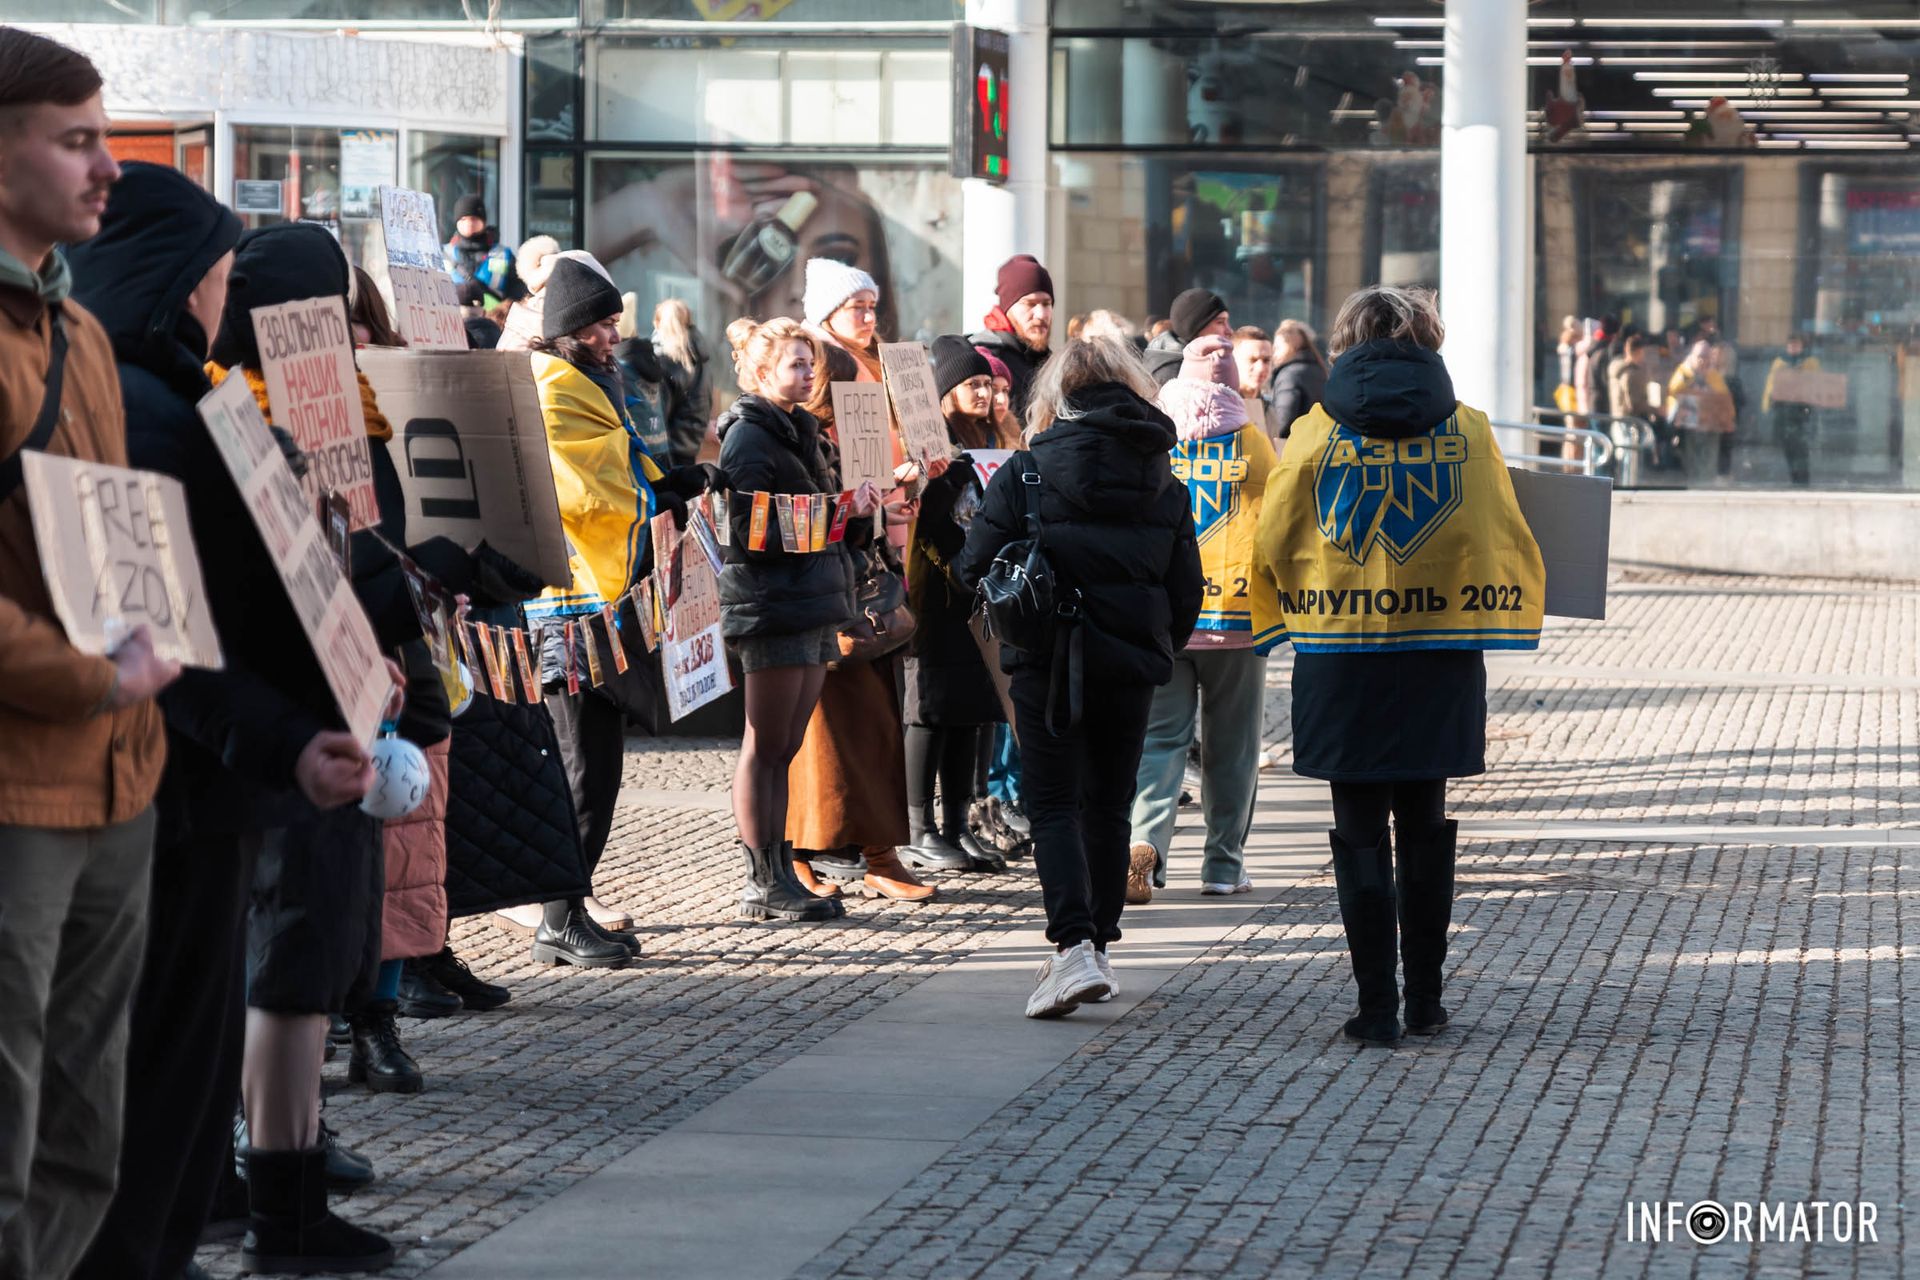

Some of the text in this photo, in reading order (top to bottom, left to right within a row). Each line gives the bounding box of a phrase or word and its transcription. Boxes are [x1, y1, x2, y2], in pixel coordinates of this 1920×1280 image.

[260, 302, 345, 360] ЗВІЛЬНІТЬ
[282, 353, 343, 404] НАШИХ
[288, 396, 353, 449] РІДНИХ
[843, 393, 880, 434] FREE
[1170, 457, 1249, 483] ЗОВ
[1329, 433, 1467, 468] АЗОВ
[77, 471, 168, 549] FREE
[1277, 586, 1448, 616] МАРІУПОЛЬ
[1460, 584, 1522, 612] 2022
